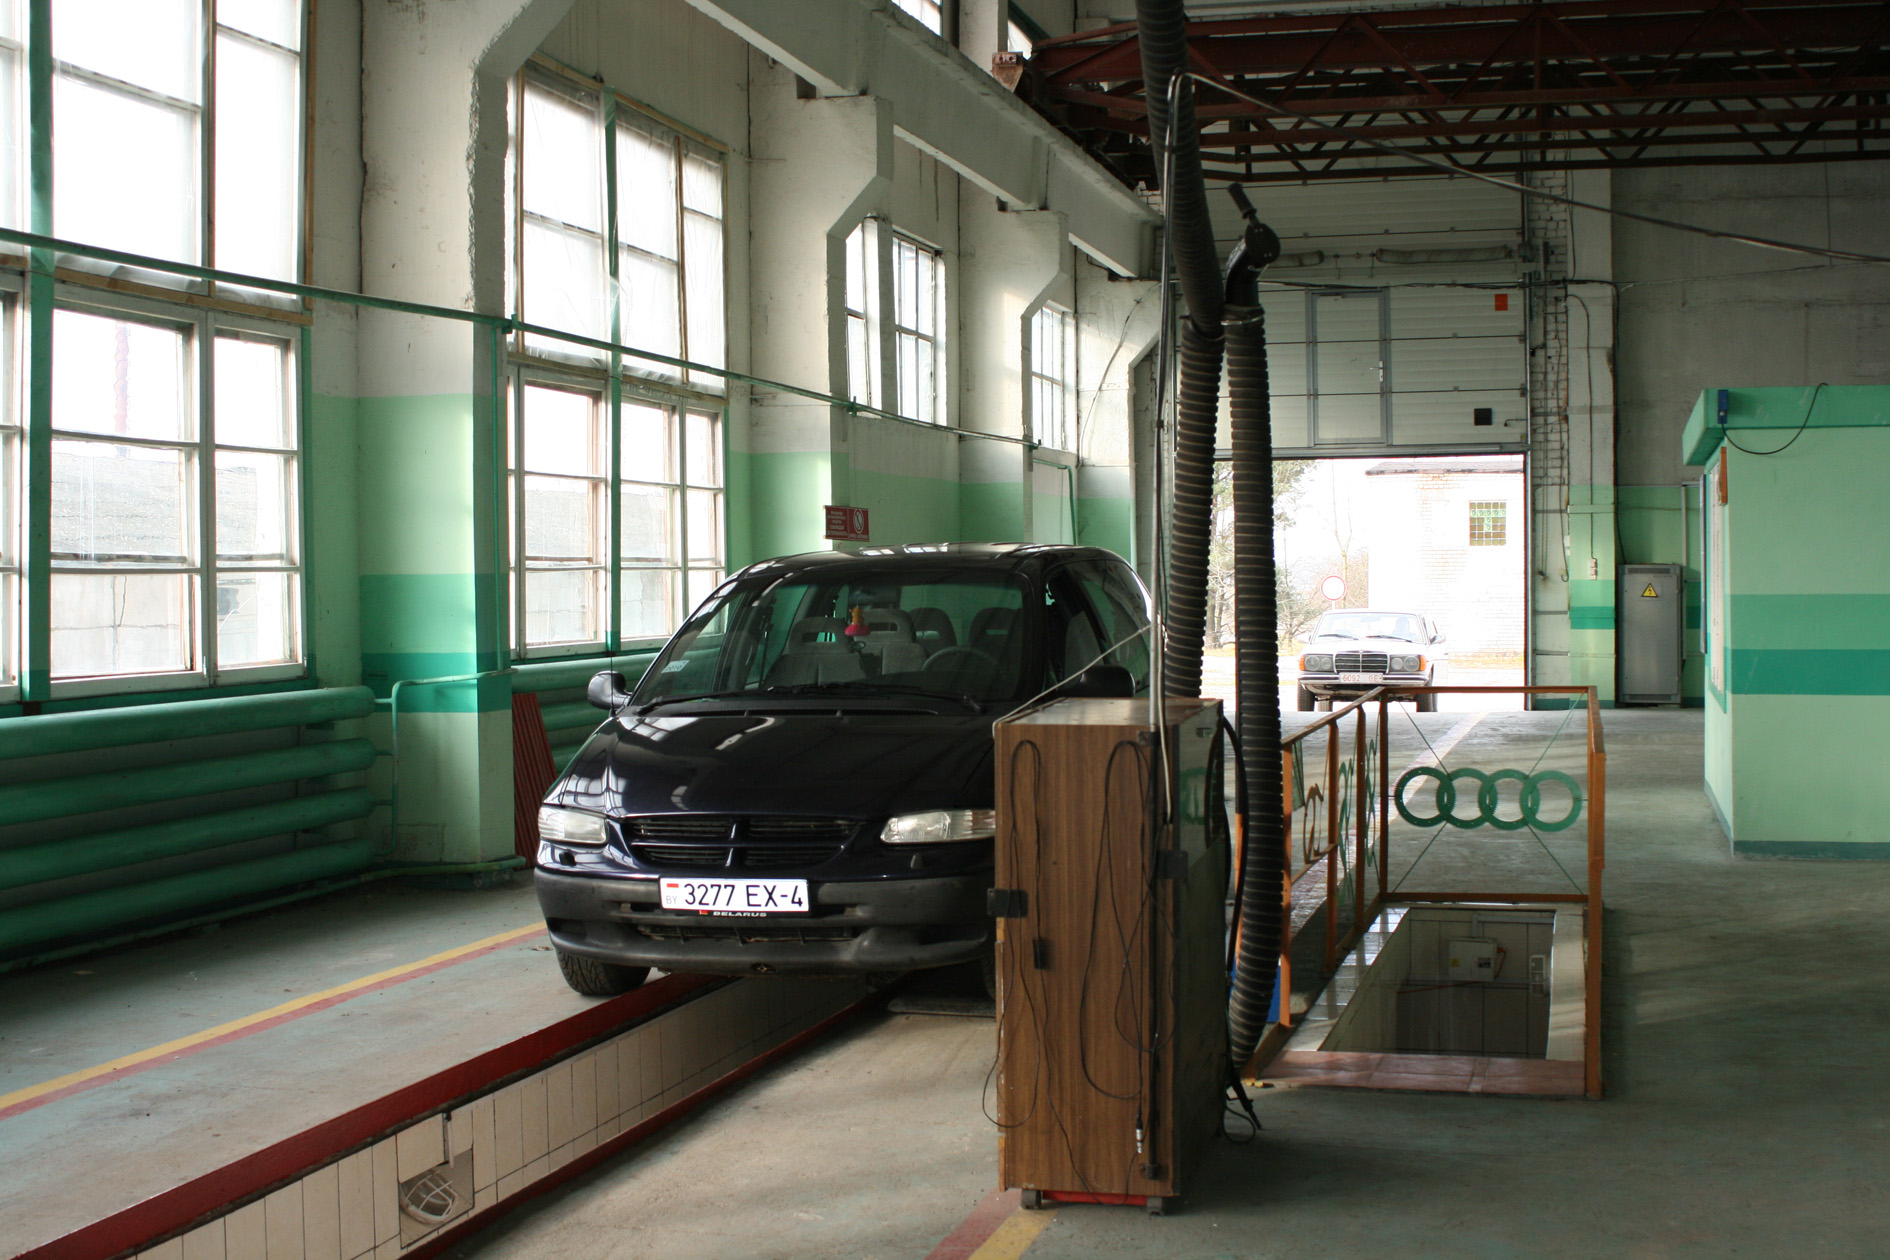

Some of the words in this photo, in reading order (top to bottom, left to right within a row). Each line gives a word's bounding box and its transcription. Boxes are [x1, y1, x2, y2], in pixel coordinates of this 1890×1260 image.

[666, 895, 678, 905] BY
[684, 883, 735, 907] 3277
[746, 885, 803, 907] EX-4
